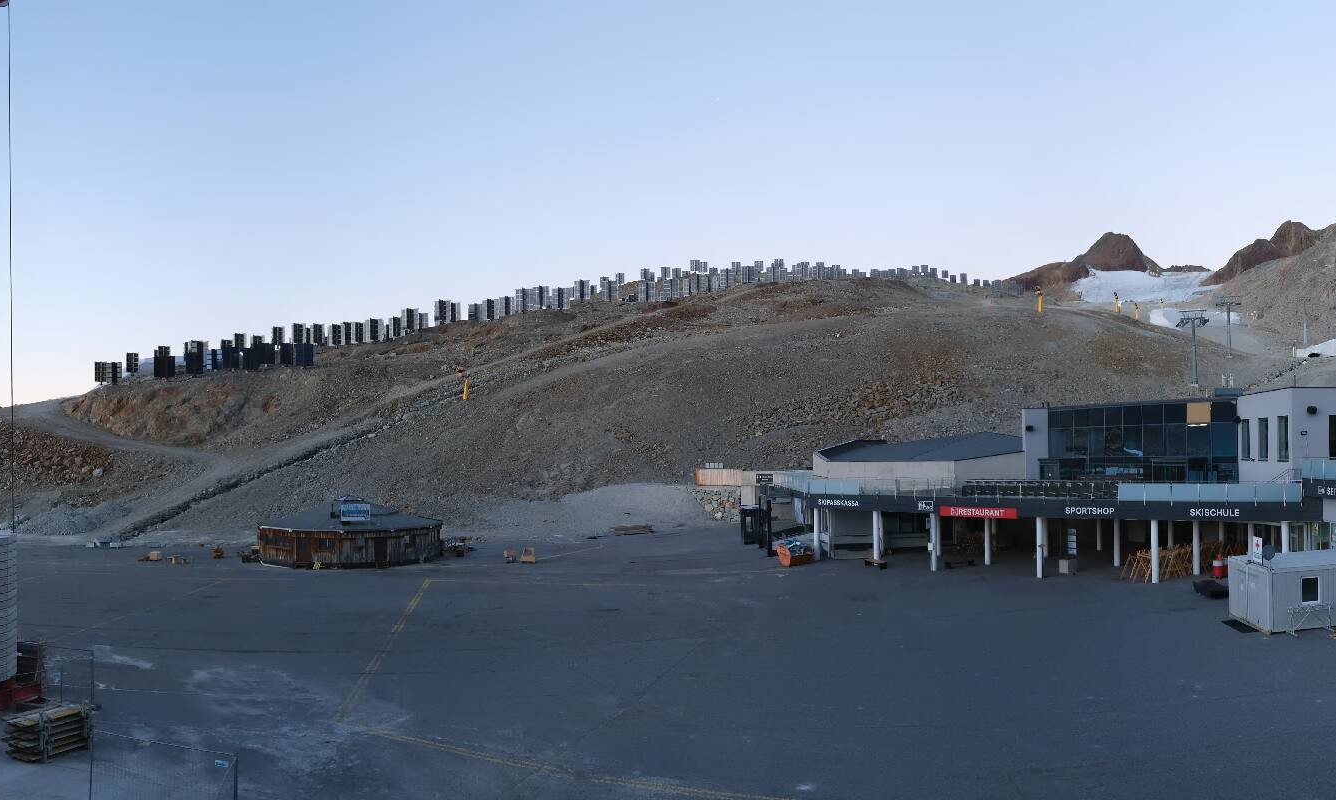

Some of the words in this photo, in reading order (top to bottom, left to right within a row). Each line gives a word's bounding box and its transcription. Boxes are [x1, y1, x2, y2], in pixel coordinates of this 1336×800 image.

[958, 507, 1005, 517] RESTAURANT
[1065, 506, 1115, 516] SPORTSHOP
[1190, 508, 1240, 517] SKISCHULE
